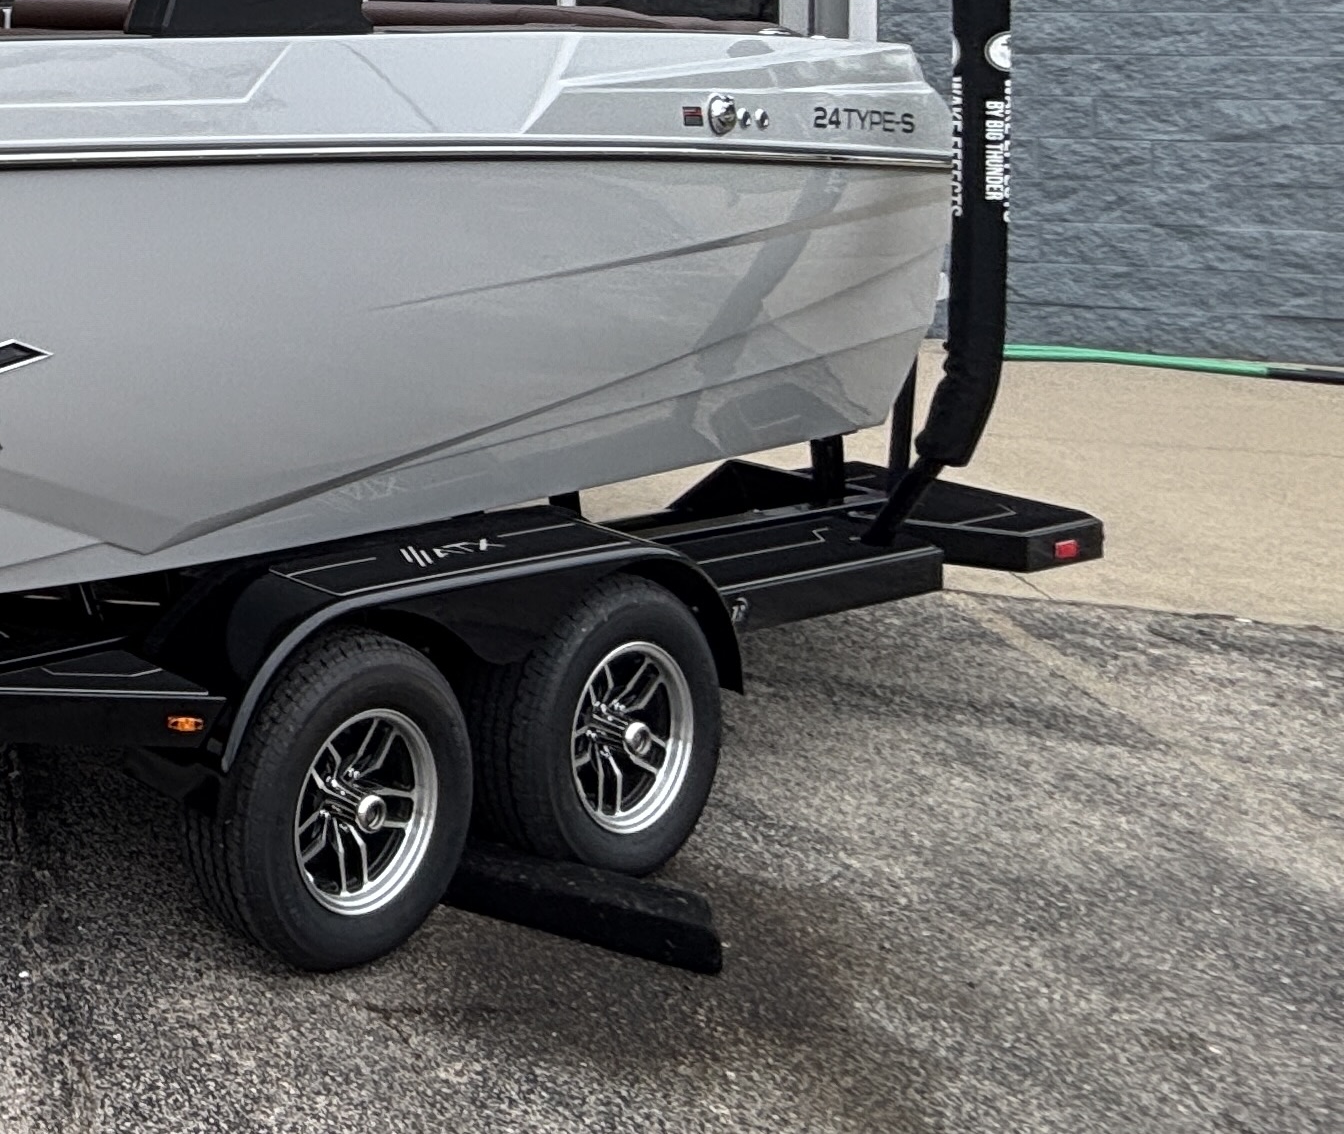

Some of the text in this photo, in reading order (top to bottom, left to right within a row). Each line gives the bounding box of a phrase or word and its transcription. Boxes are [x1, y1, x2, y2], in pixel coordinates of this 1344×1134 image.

[985, 101, 1004, 200] BY BIG THUNDER
